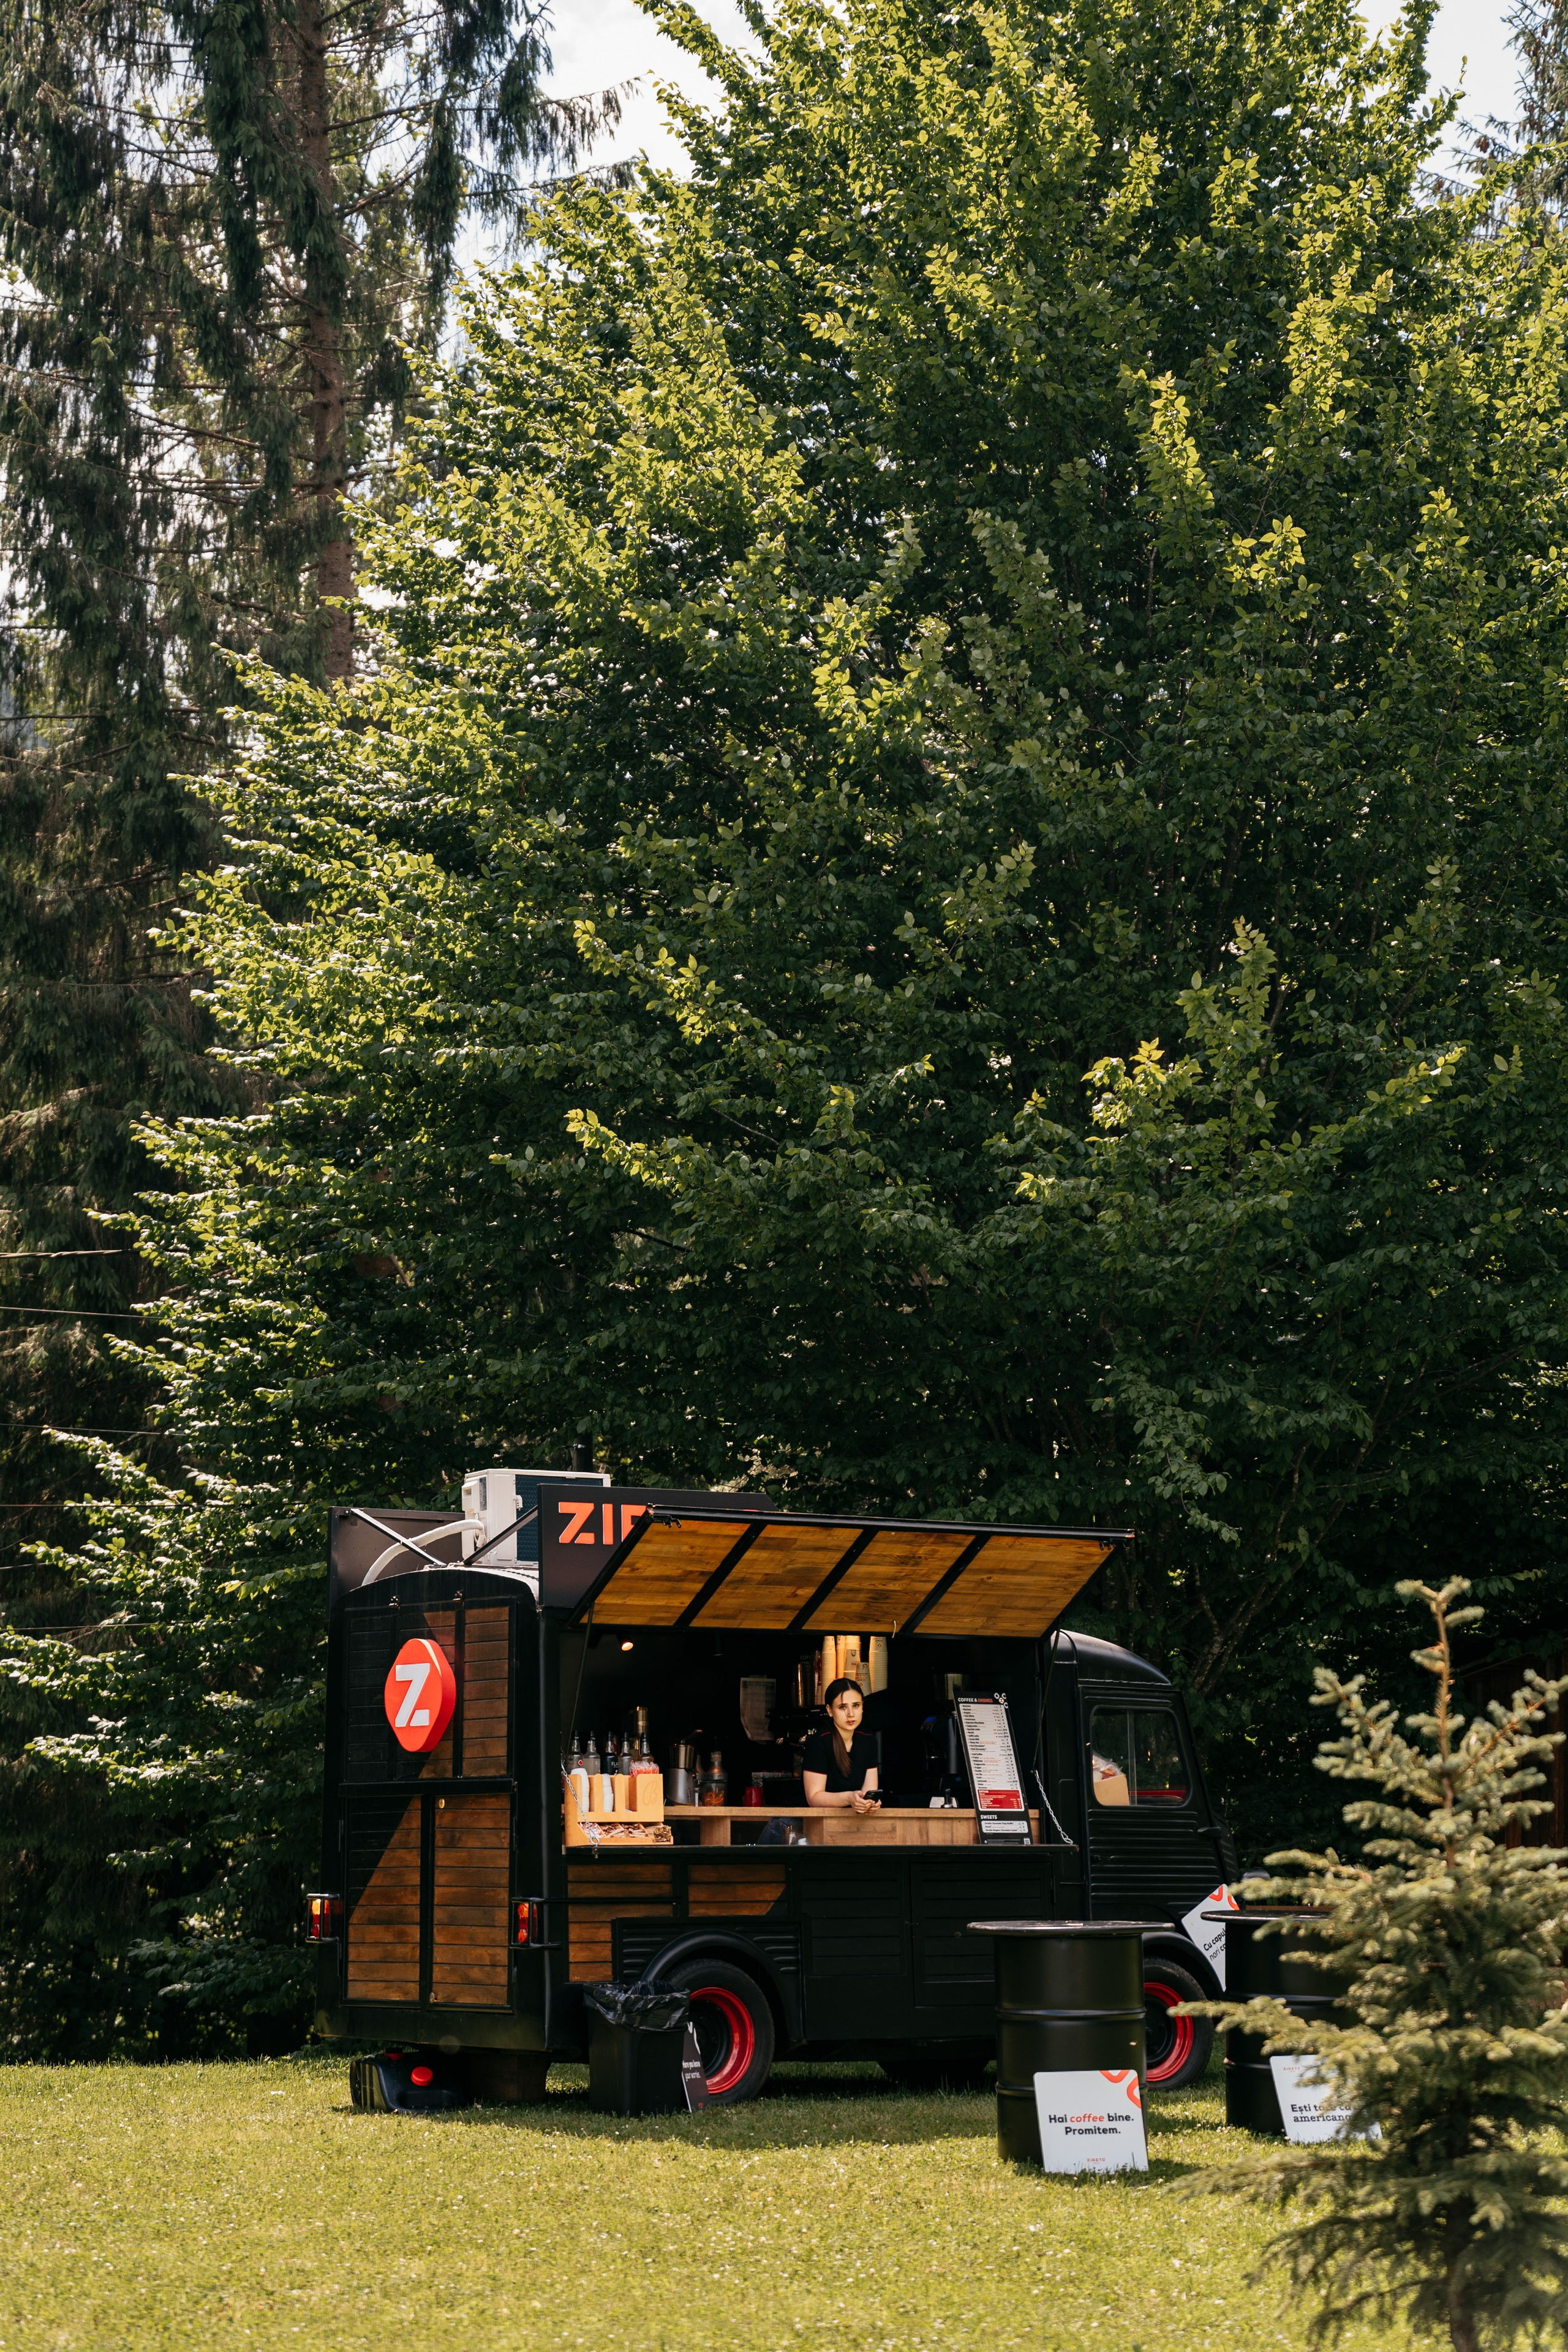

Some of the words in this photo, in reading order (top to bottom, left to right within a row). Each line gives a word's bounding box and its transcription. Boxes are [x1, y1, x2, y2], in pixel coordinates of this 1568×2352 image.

[1204, 1942, 1212, 1951] Cu
[1209, 1947, 1221, 1961] nori
[1291, 2104, 1311, 2114] Ești
[1049, 2114, 1067, 2123] Hai
[1065, 2126, 1121, 2135] Promitem.
